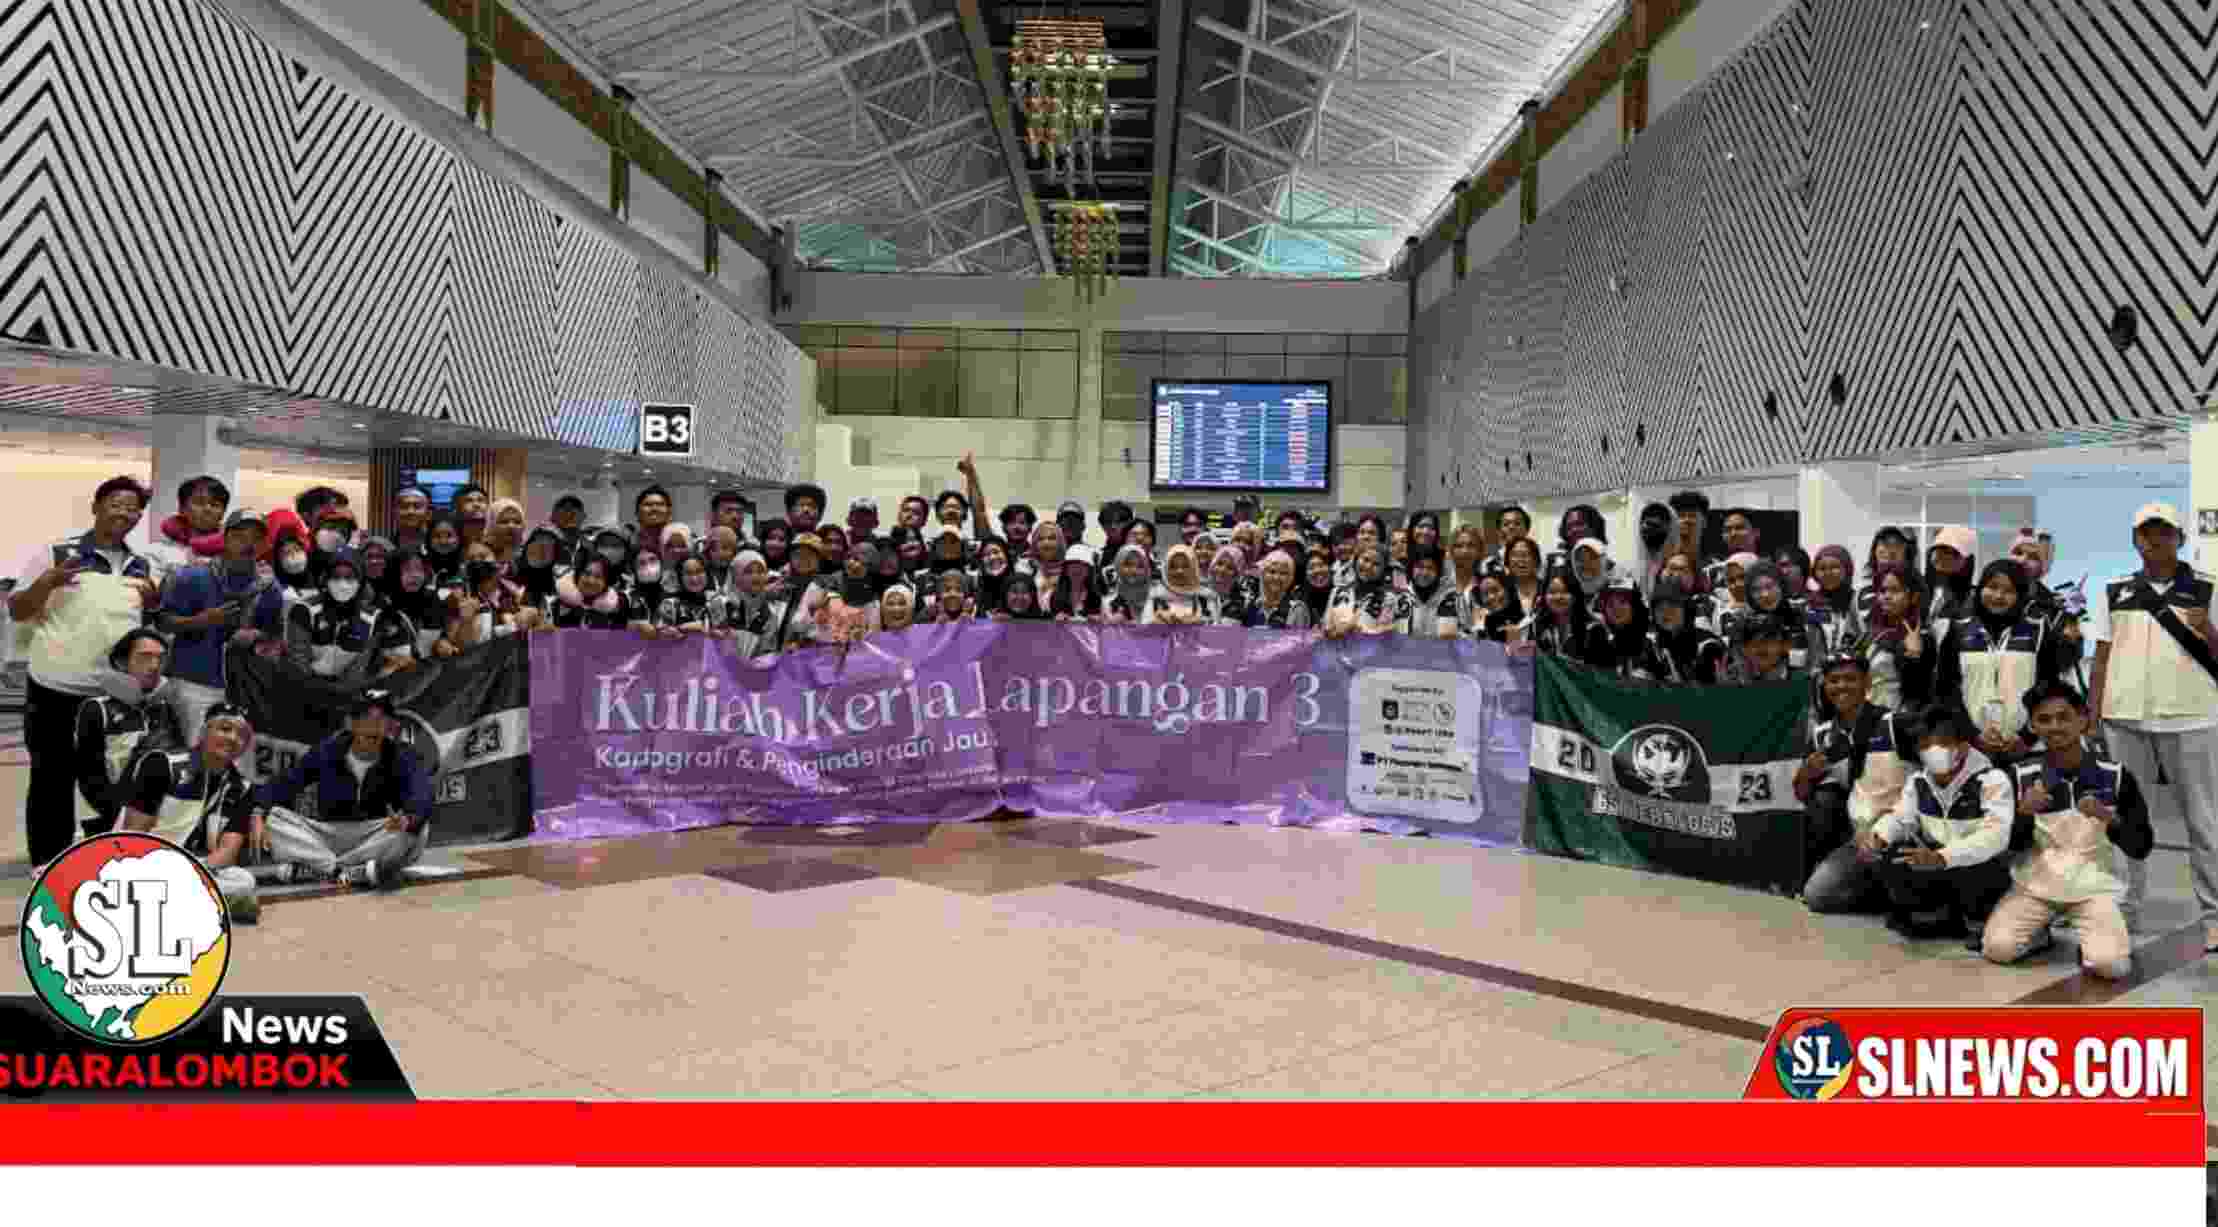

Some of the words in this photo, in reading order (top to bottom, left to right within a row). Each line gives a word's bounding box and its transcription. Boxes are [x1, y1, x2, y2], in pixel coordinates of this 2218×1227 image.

[647, 415, 689, 444] B3
[594, 654, 792, 743] Kuliah
[800, 664, 961, 741] Kerja
[1295, 673, 1321, 727] 3
[466, 723, 502, 758] 23
[735, 748, 757, 770] &
[943, 728, 999, 752] Jau
[1557, 740, 1594, 771] 20
[1738, 773, 1772, 804] 23
